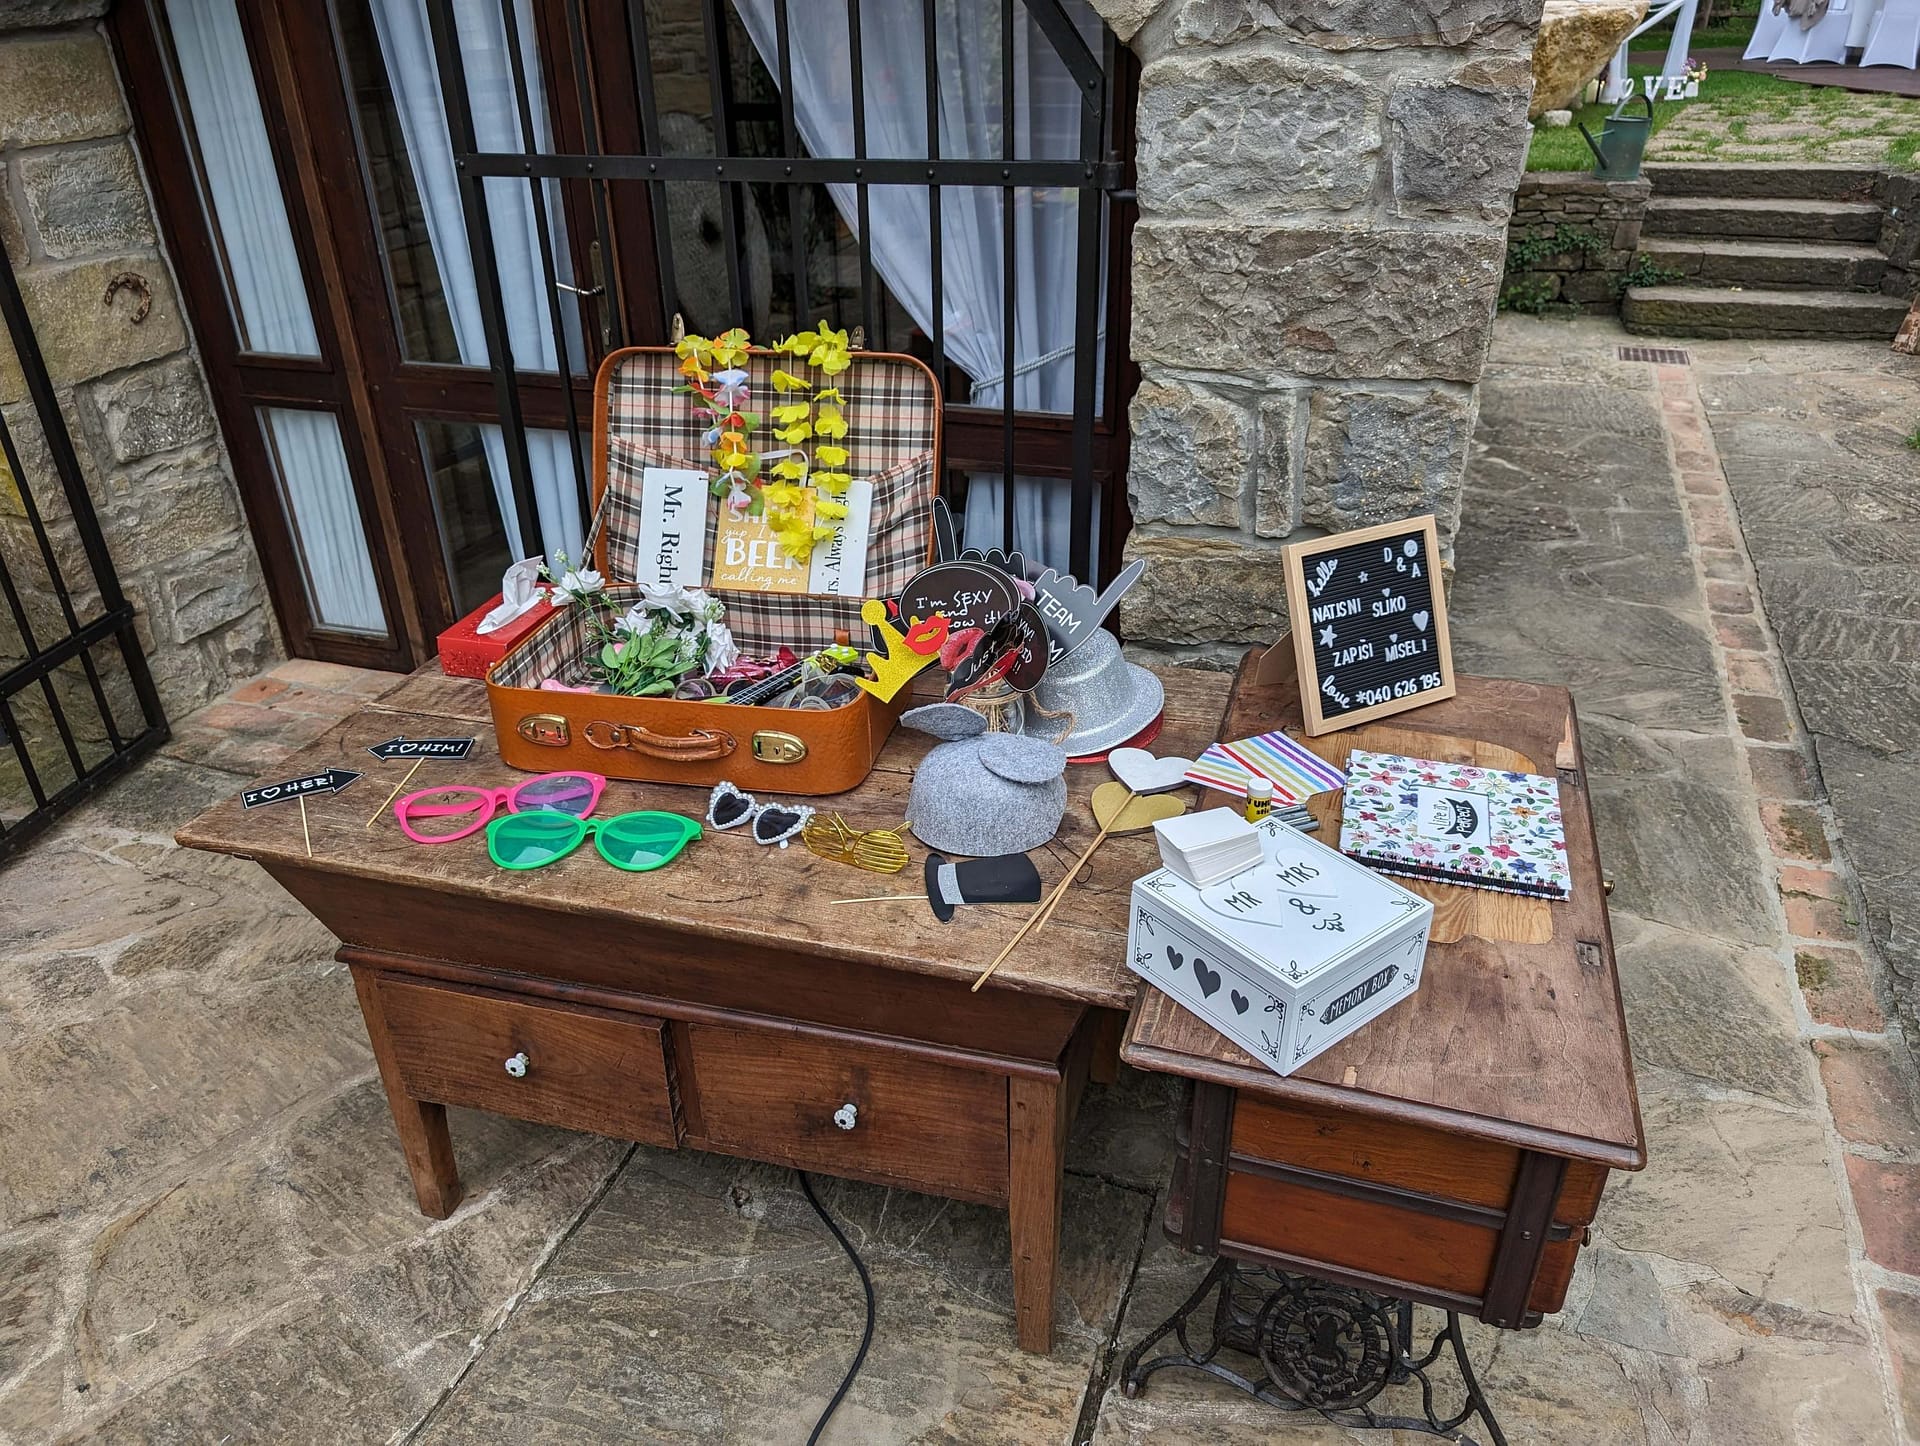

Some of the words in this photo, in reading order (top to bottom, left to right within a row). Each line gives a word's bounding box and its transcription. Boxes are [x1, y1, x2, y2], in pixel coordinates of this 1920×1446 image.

[662, 484, 683, 522] Mr.
[824, 526, 847, 572] Always
[721, 567, 774, 590] calling
[777, 577, 797, 585] me
[1307, 559, 1339, 597] hello
[916, 596, 948, 609] I'm
[953, 588, 993, 608] SEXY
[1036, 588, 1082, 634] TEAM
[1321, 675, 1350, 708] love
[1394, 678, 1417, 698] 626
[419, 743, 463, 753] HIM!
[285, 775, 334, 793] HER!
[1276, 862, 1320, 888] MRS
[1224, 891, 1262, 913] MR
[1288, 898, 1321, 915] &
[1330, 981, 1369, 1020] MEMORY
[1371, 968, 1390, 993] BOX
